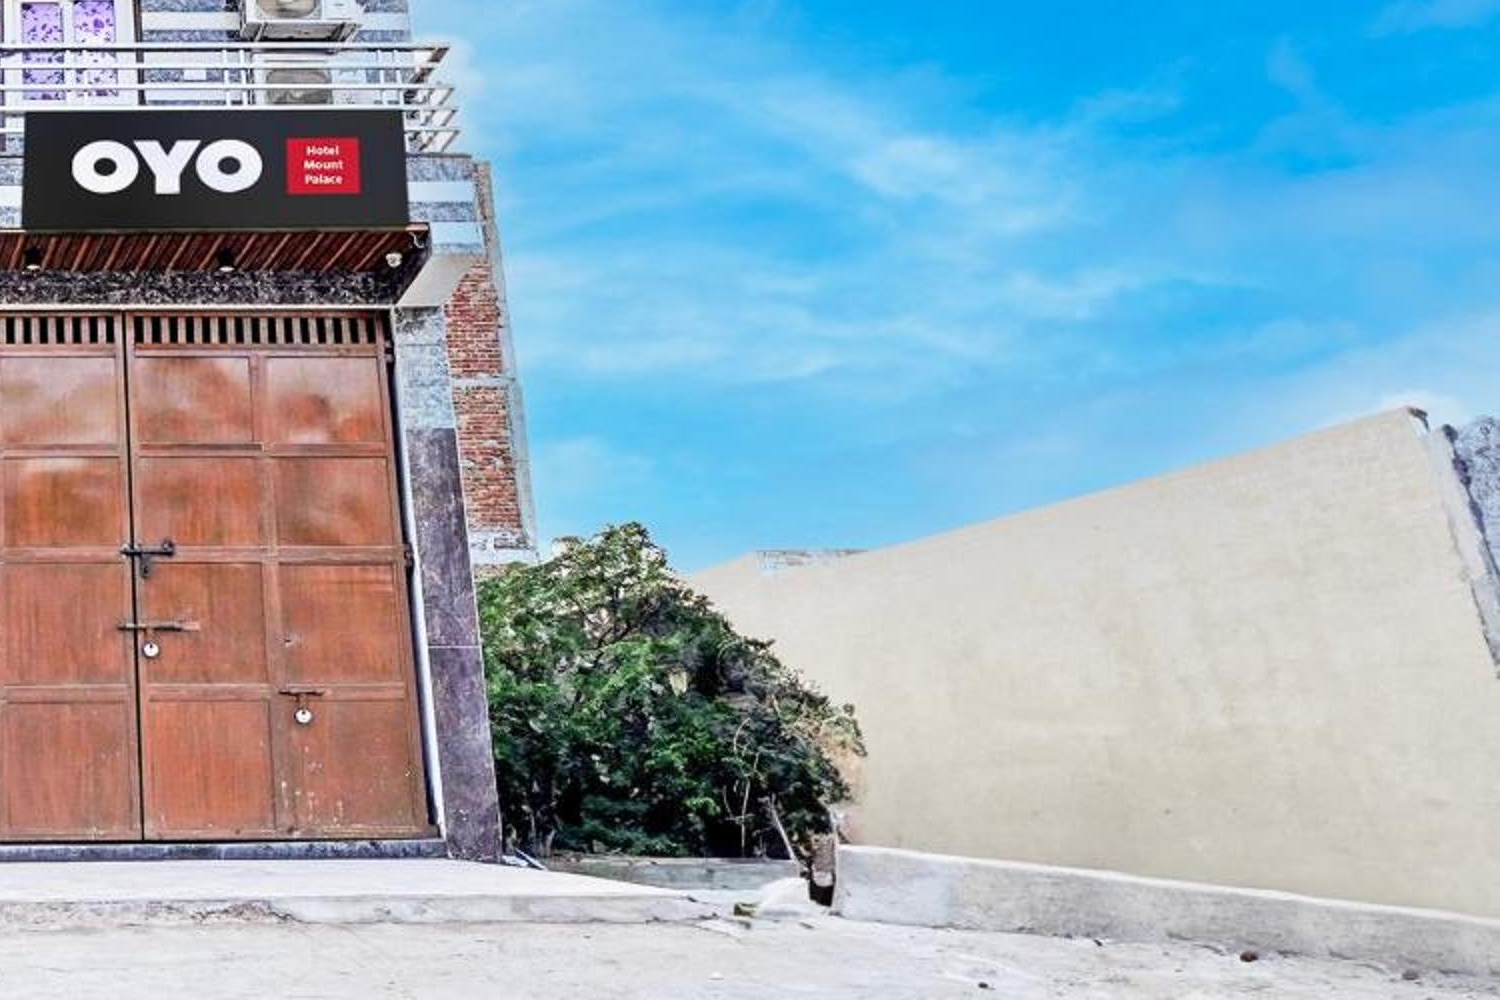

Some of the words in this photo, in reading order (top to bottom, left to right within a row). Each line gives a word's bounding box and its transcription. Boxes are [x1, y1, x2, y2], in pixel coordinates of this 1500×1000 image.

[306, 145, 340, 156] Hotel
[71, 139, 263, 195] OYO
[303, 160, 343, 170] Mount
[304, 174, 343, 185] Palace
